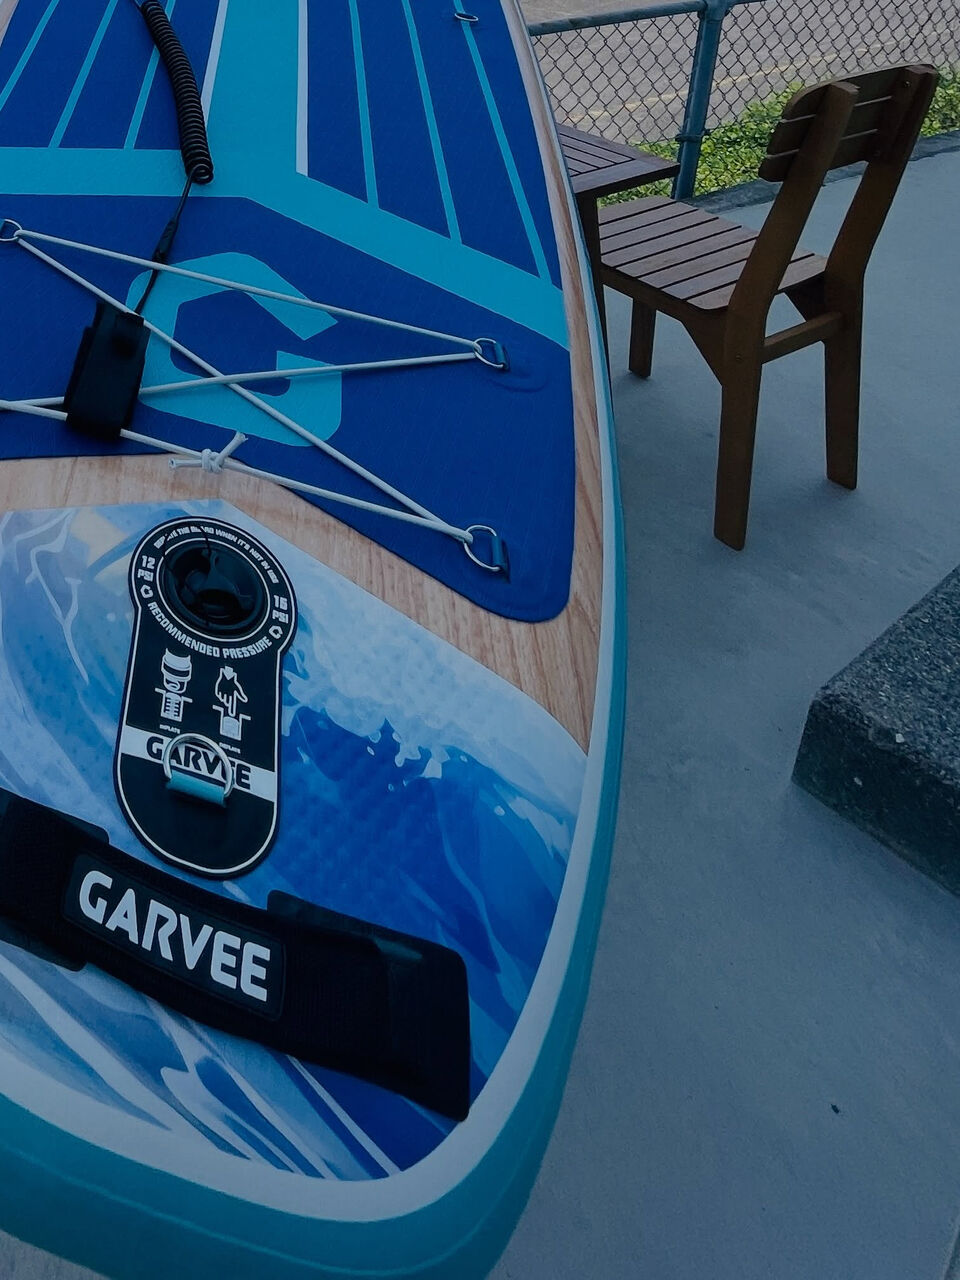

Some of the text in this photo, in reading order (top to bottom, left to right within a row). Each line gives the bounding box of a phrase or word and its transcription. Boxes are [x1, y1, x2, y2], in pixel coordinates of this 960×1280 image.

[215, 528, 238, 543] WHEN
[249, 548, 264, 561] NOT
[142, 555, 156, 569] 12
[137, 568, 154, 582] PSI
[272, 609, 289, 624] PSI
[147, 601, 273, 660] RECOMMENDED PRESSURE
[79, 870, 271, 1002] GARVEE
